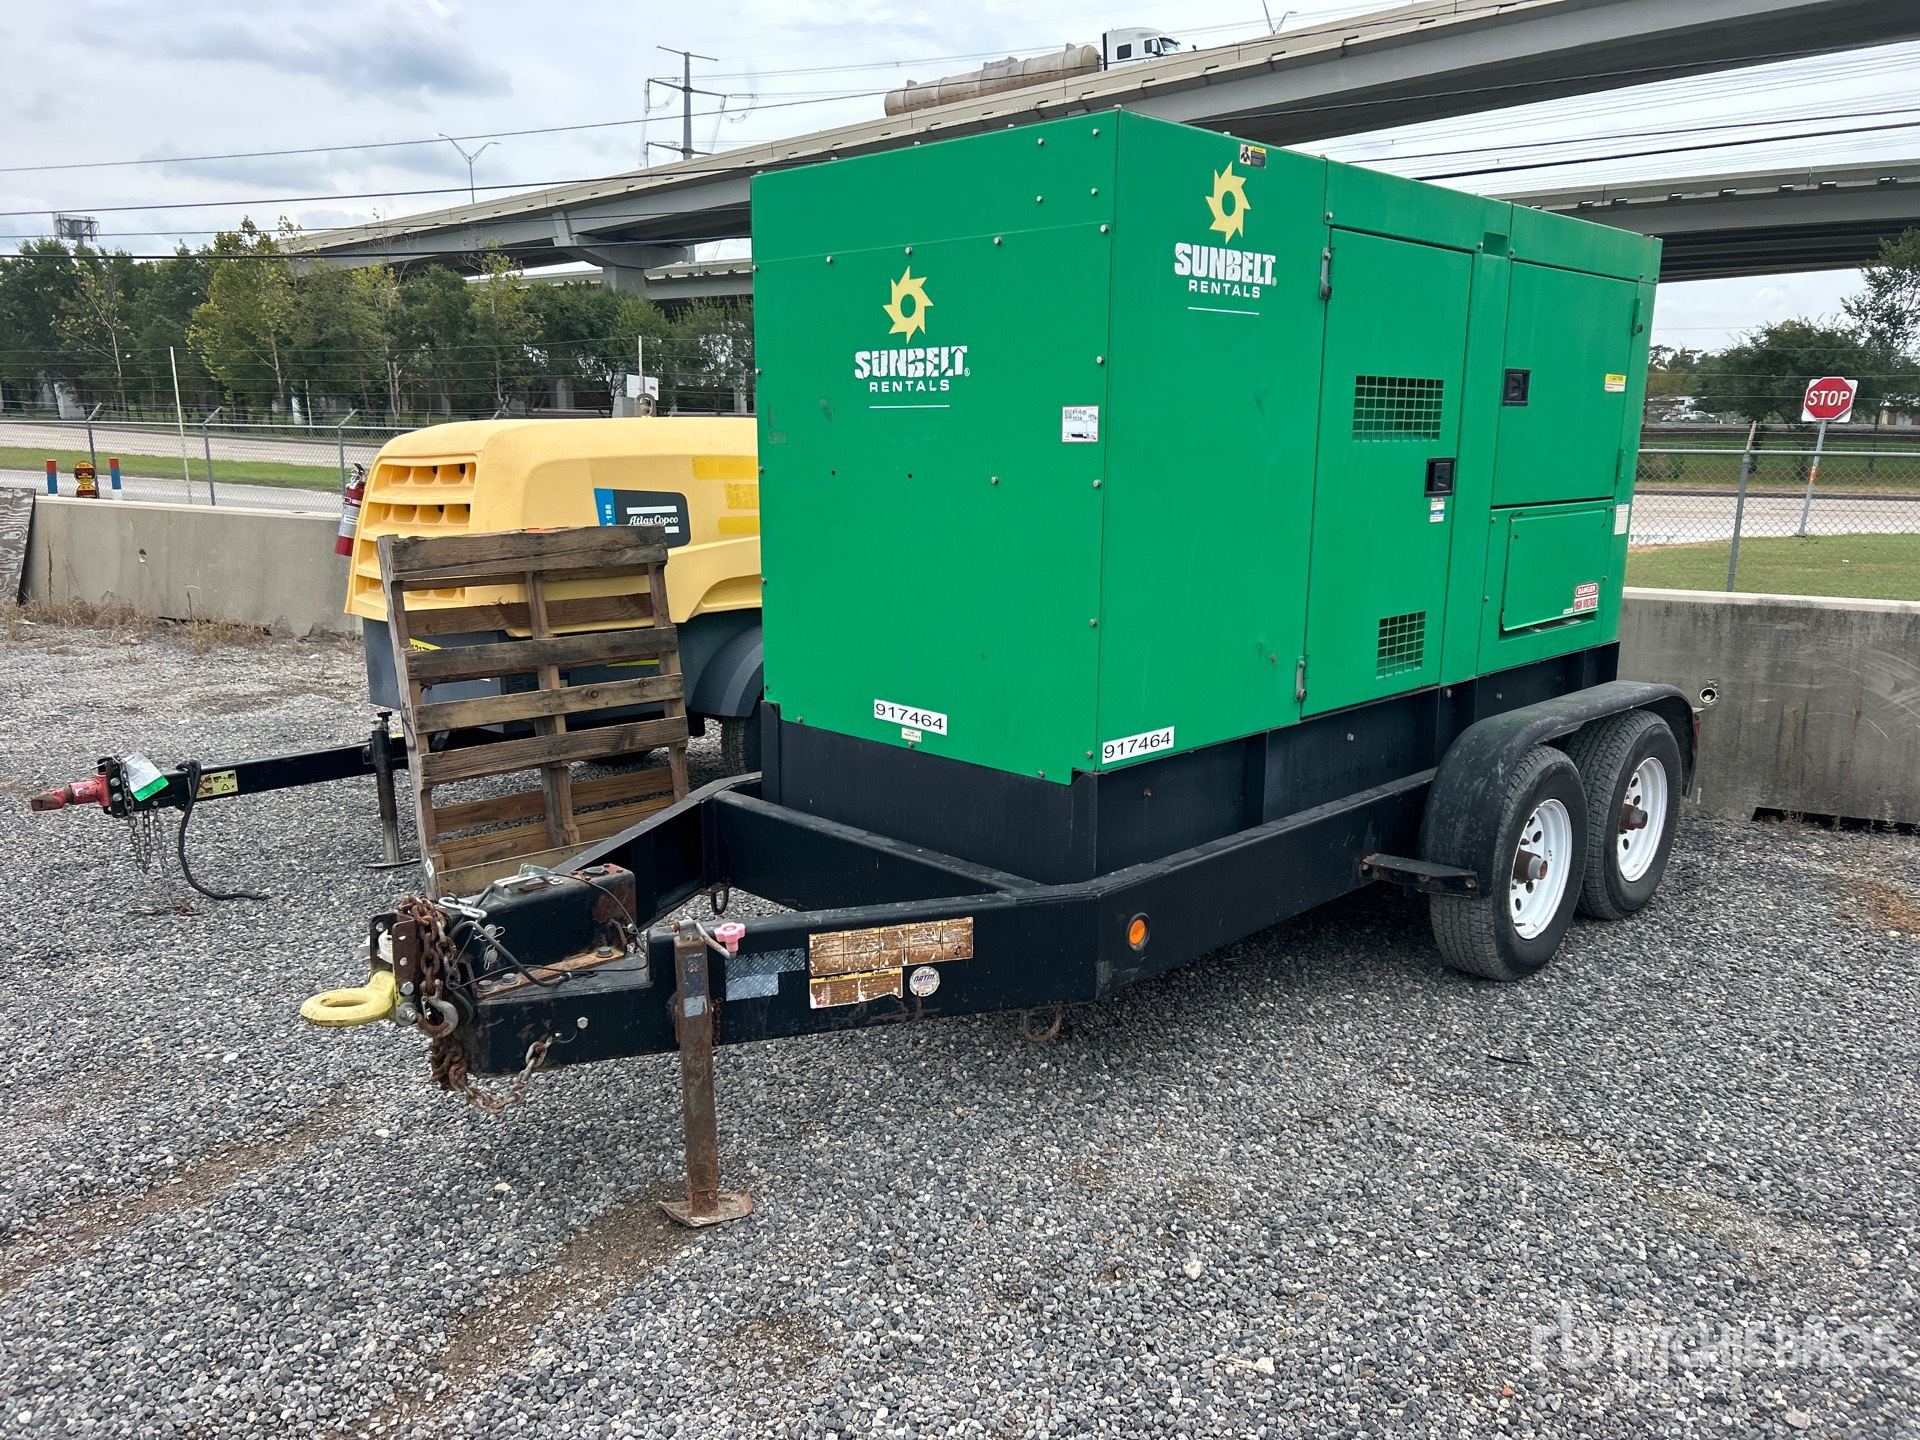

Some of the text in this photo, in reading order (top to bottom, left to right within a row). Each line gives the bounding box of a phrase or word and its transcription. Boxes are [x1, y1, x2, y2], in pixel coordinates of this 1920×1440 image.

[1174, 242, 1276, 285] SUNBELT
[1188, 279, 1260, 298] RENTALS
[854, 346, 968, 379] SUNBELT
[869, 380, 950, 392] RENTALS
[1807, 390, 1850, 406] STOP
[628, 514, 679, 526] Atlas Copco
[875, 703, 944, 731] 917464
[1104, 731, 1171, 759] 917464
